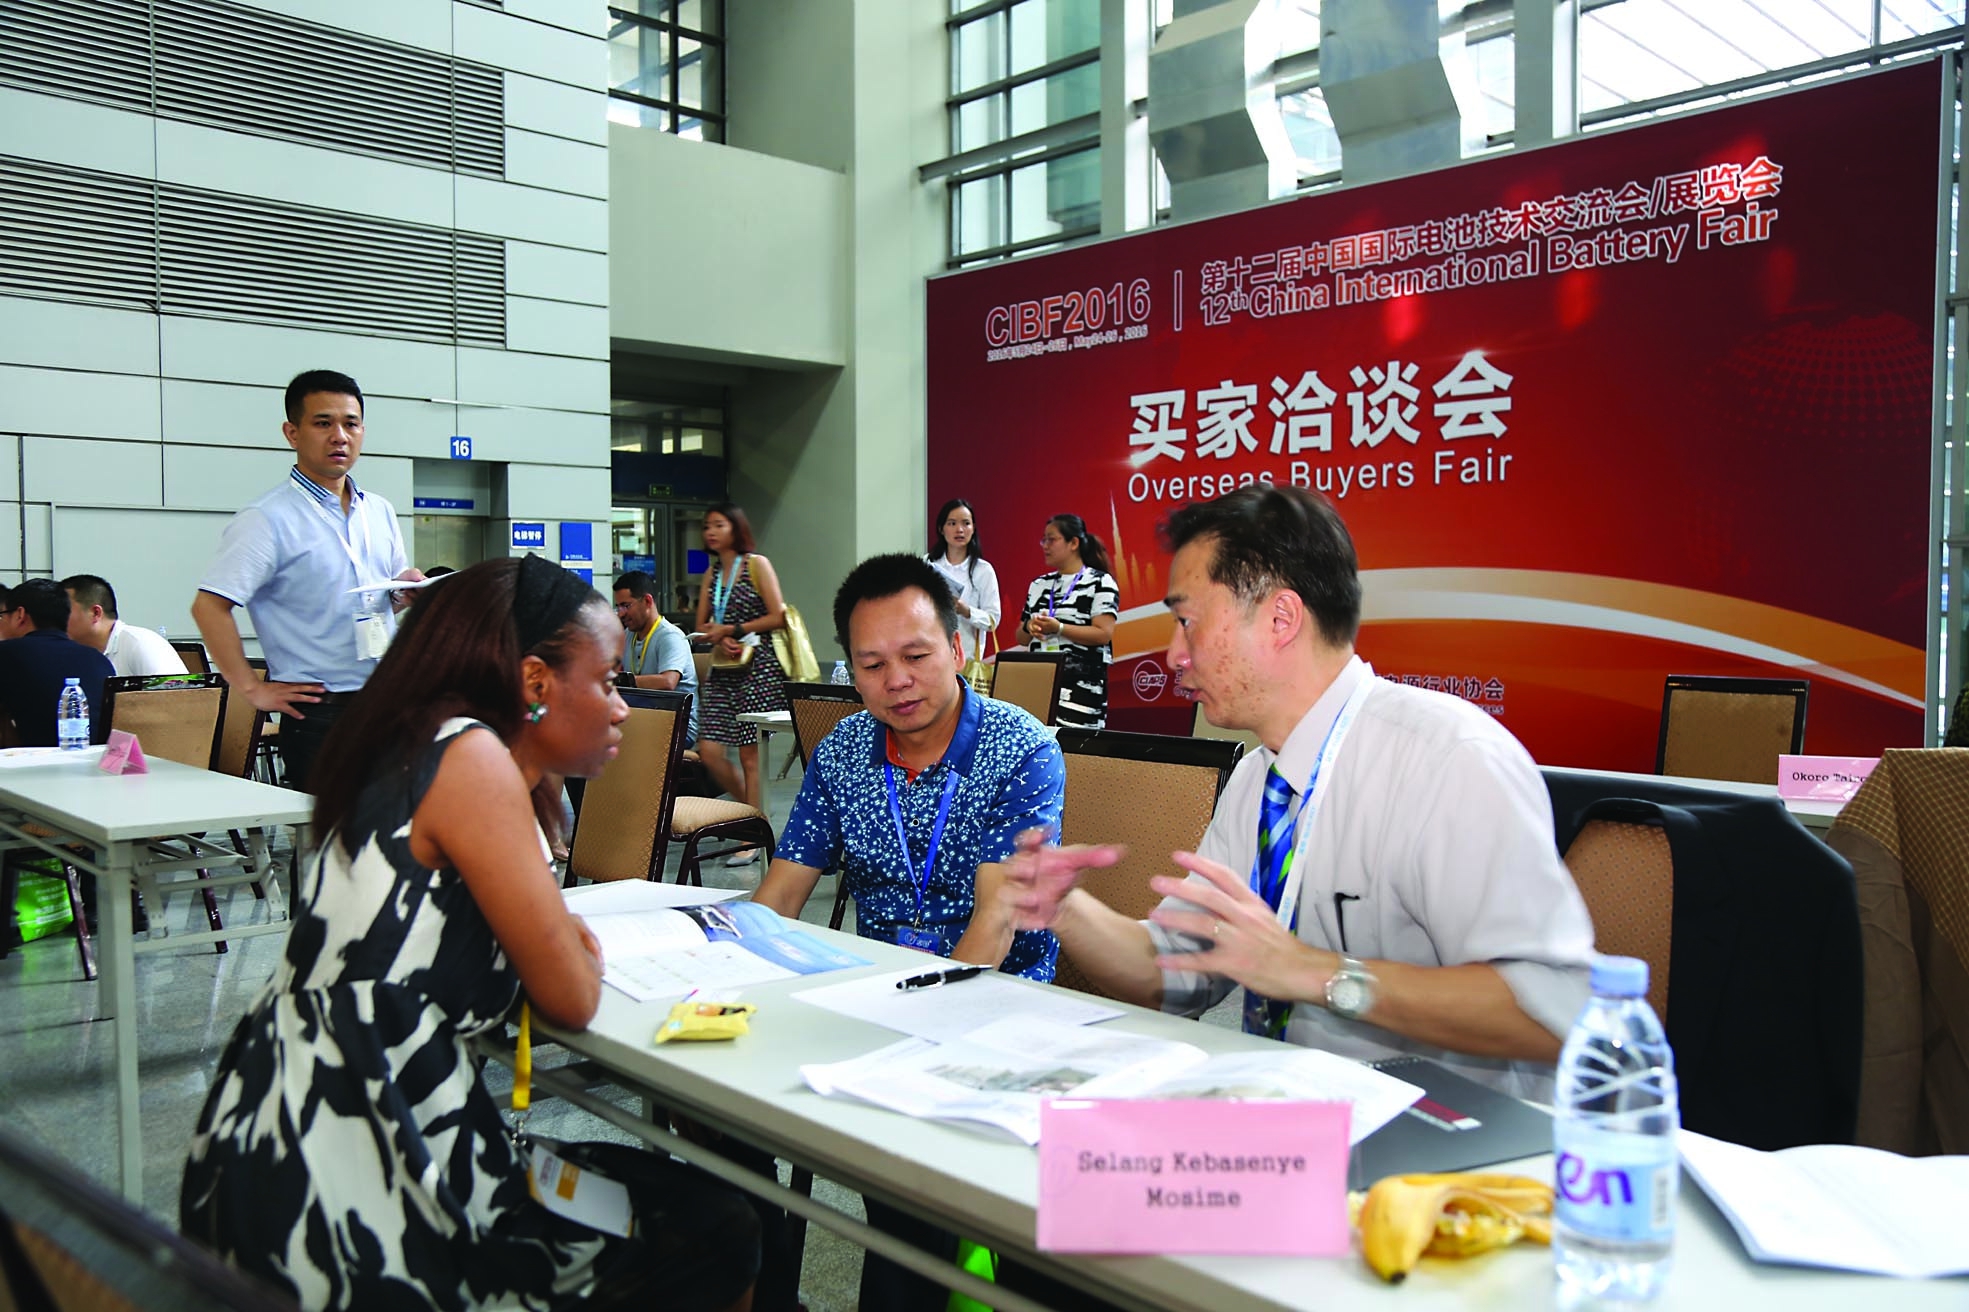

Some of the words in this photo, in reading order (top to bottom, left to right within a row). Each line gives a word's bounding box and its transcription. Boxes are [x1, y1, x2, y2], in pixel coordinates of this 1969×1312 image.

[1201, 156, 1783, 295] 第十二届中国国际电池技术交流会/展览会
[1335, 241, 1540, 306] International
[1547, 223, 1690, 273] Battery
[1697, 201, 1779, 250] Fair
[986, 278, 1151, 347] CIBF2016
[1128, 349, 1514, 467] 买家洽谈会
[453, 440, 470, 457] 16
[1290, 461, 1415, 498] Buyers
[1433, 447, 1513, 485] Fair
[1792, 771, 1829, 783] Okoro
[1077, 1151, 1163, 1174] Selang
[1171, 1151, 1306, 1174] Kebasenye
[1146, 1186, 1242, 1208] Mosime
